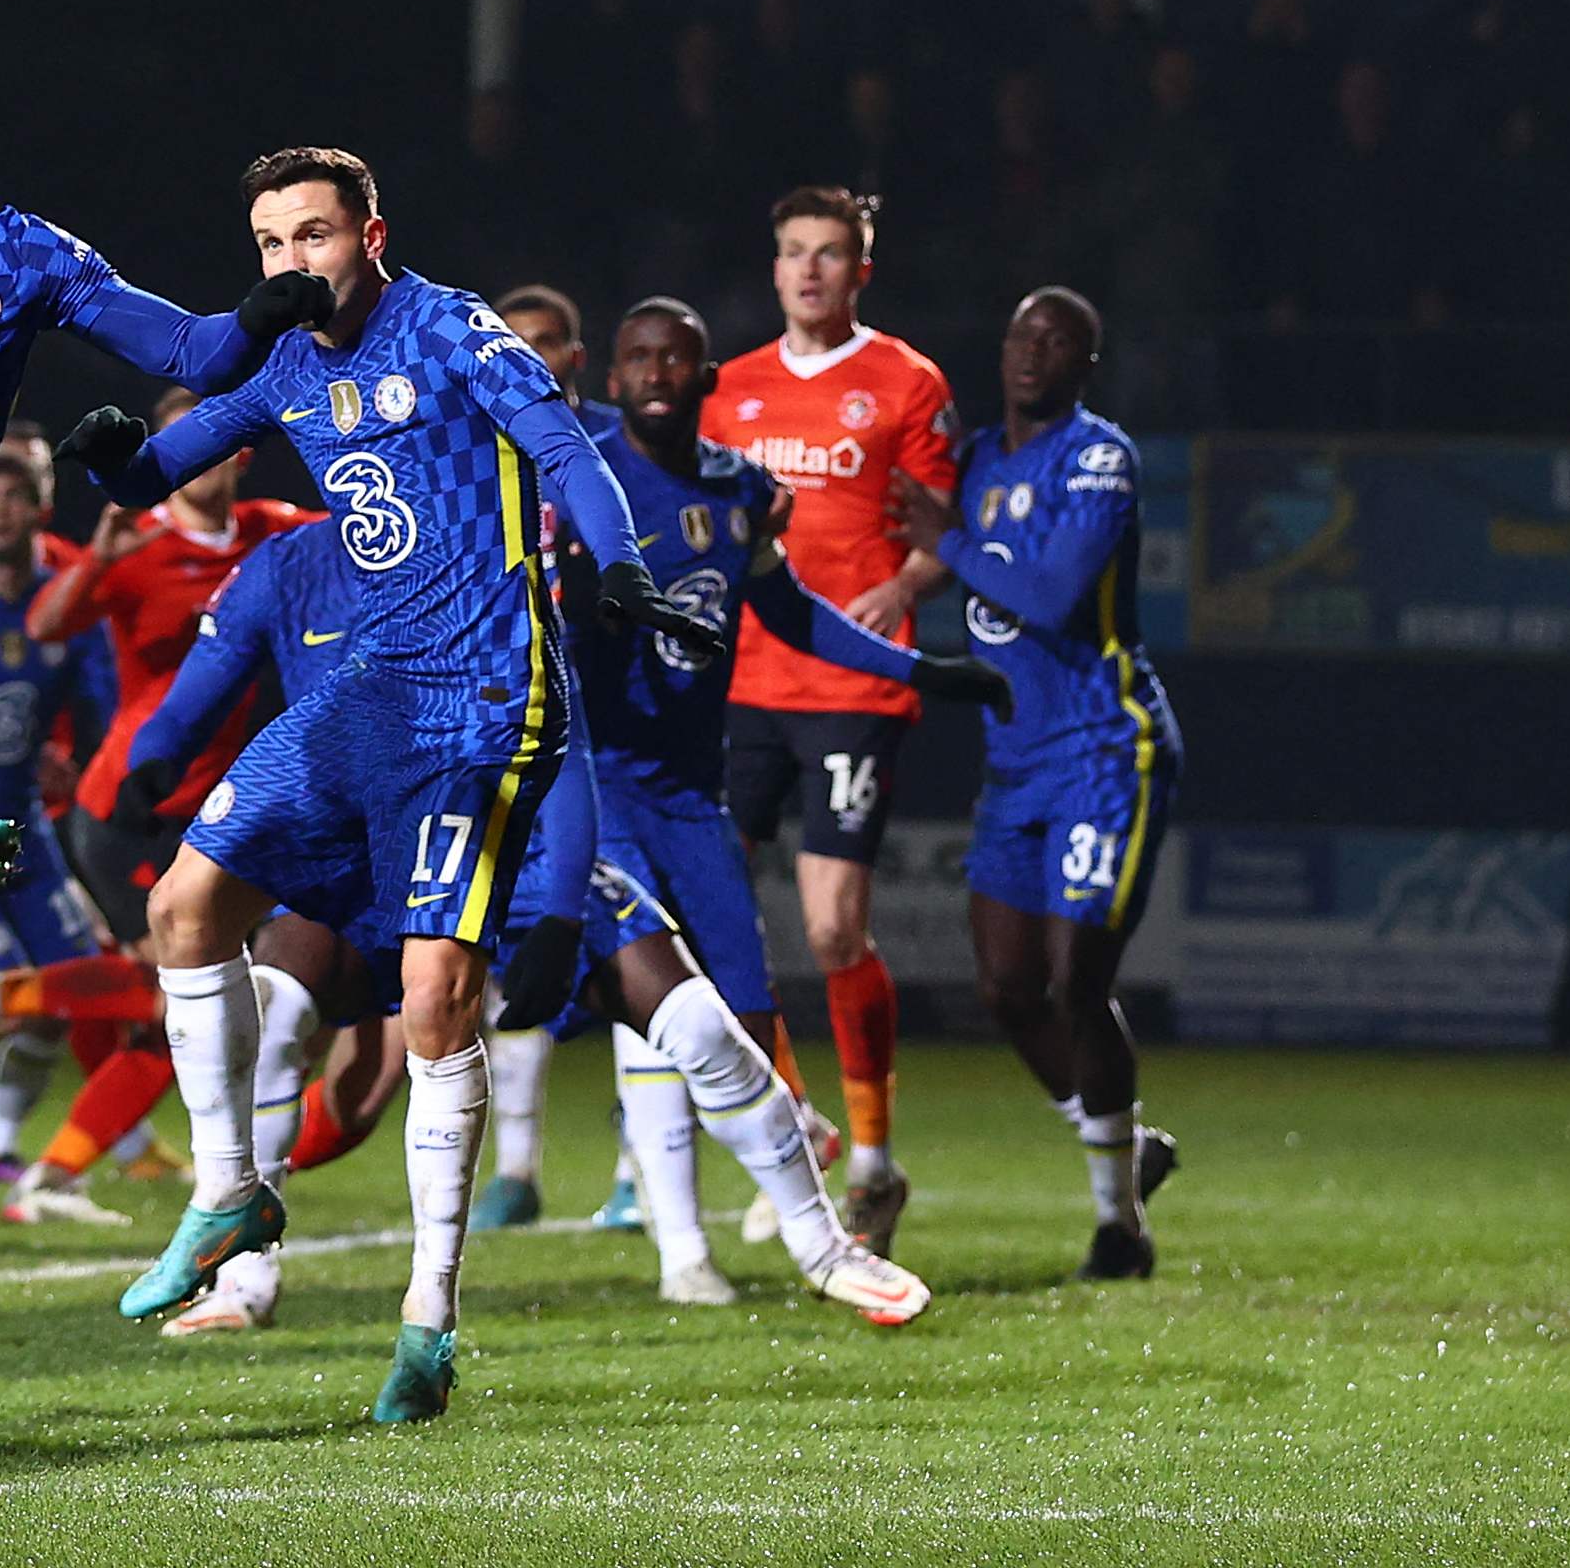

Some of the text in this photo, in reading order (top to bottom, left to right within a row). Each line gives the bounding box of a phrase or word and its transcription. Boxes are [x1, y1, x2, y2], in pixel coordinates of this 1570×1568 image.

[822, 751, 879, 816] 16
[411, 814, 473, 884] 17
[1061, 821, 1117, 889] 31
